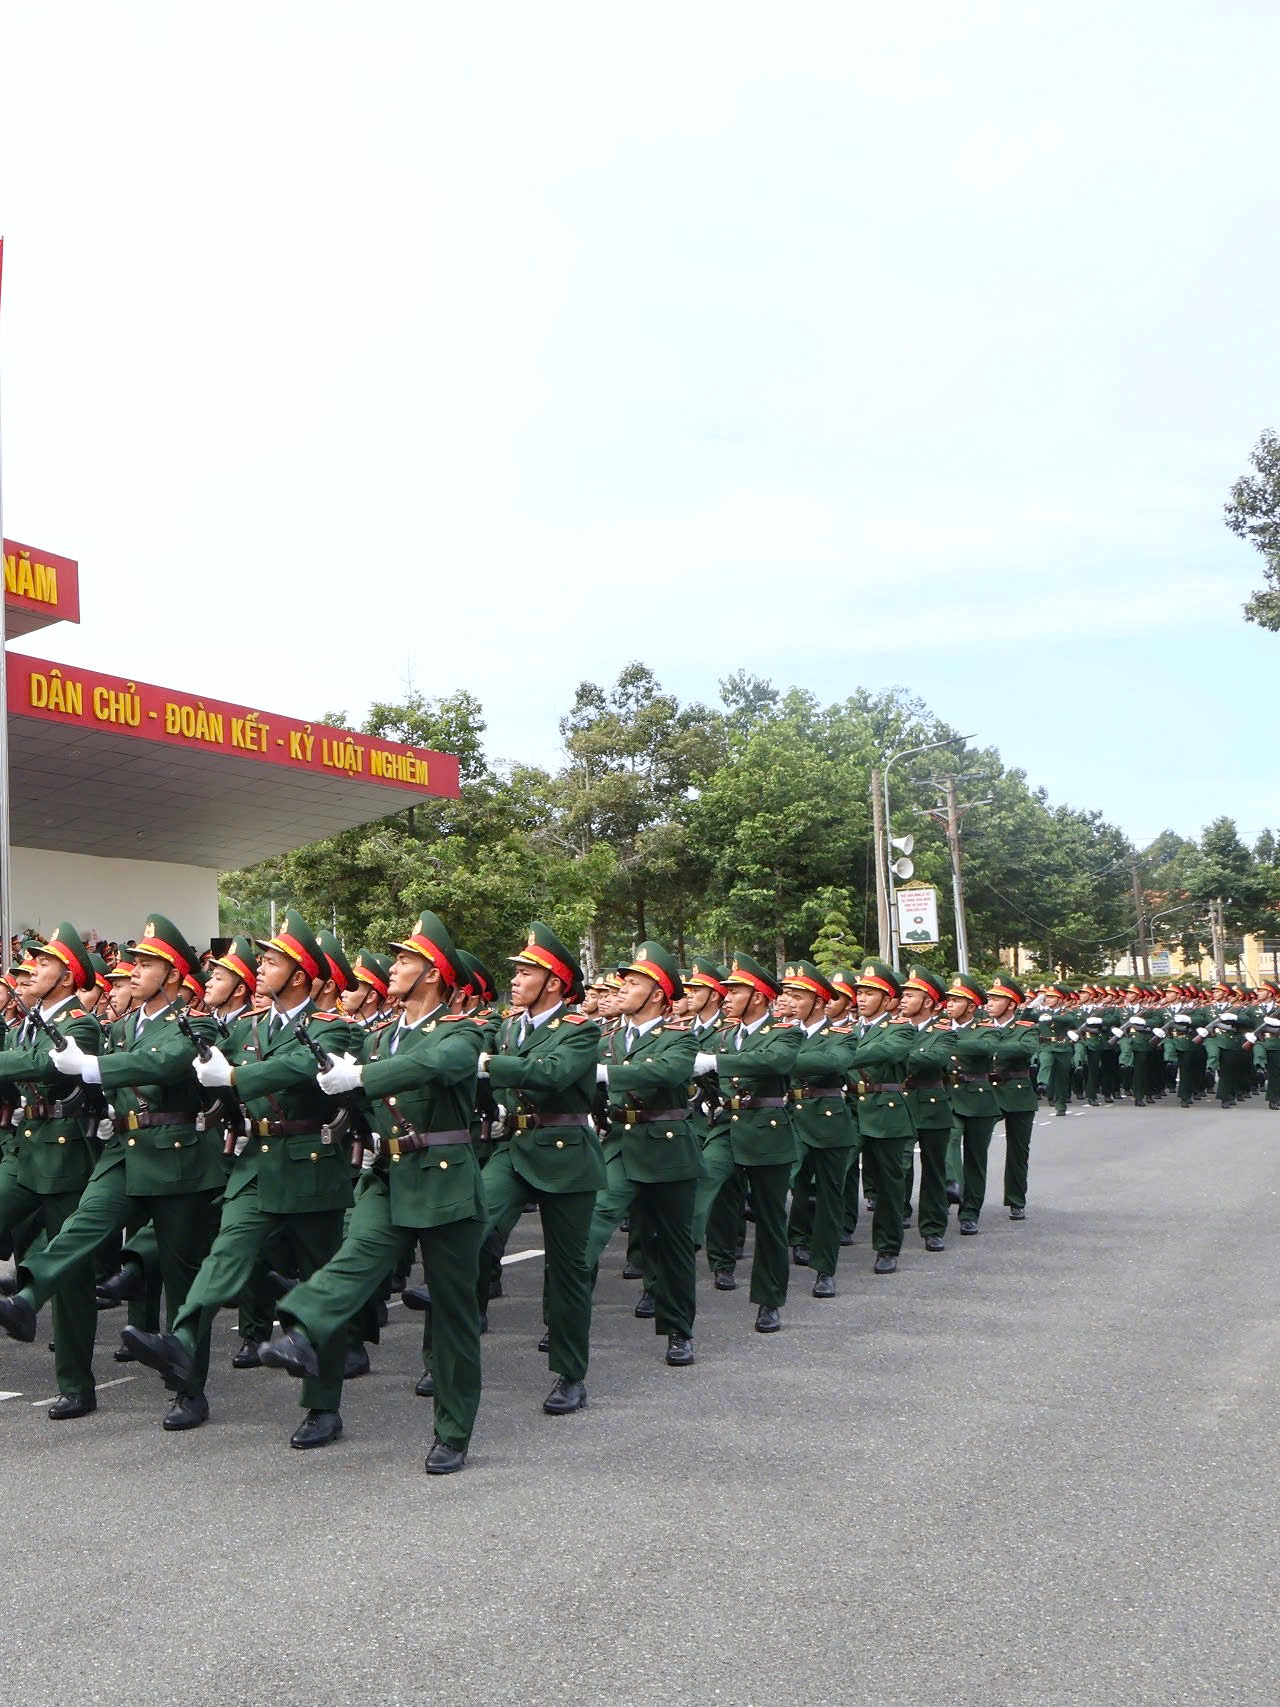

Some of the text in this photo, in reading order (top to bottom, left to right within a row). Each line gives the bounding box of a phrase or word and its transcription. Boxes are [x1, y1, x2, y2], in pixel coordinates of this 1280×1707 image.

[3, 551, 57, 606] NĂM
[30, 669, 83, 716] DÂN
[93, 682, 141, 727] CHỦ
[165, 701, 224, 744] ĐOÀN
[231, 712, 270, 752] KẾT
[289, 724, 315, 762] KỶ
[322, 736, 364, 777] LUẬT
[371, 750, 429, 786] NGHIÊM
